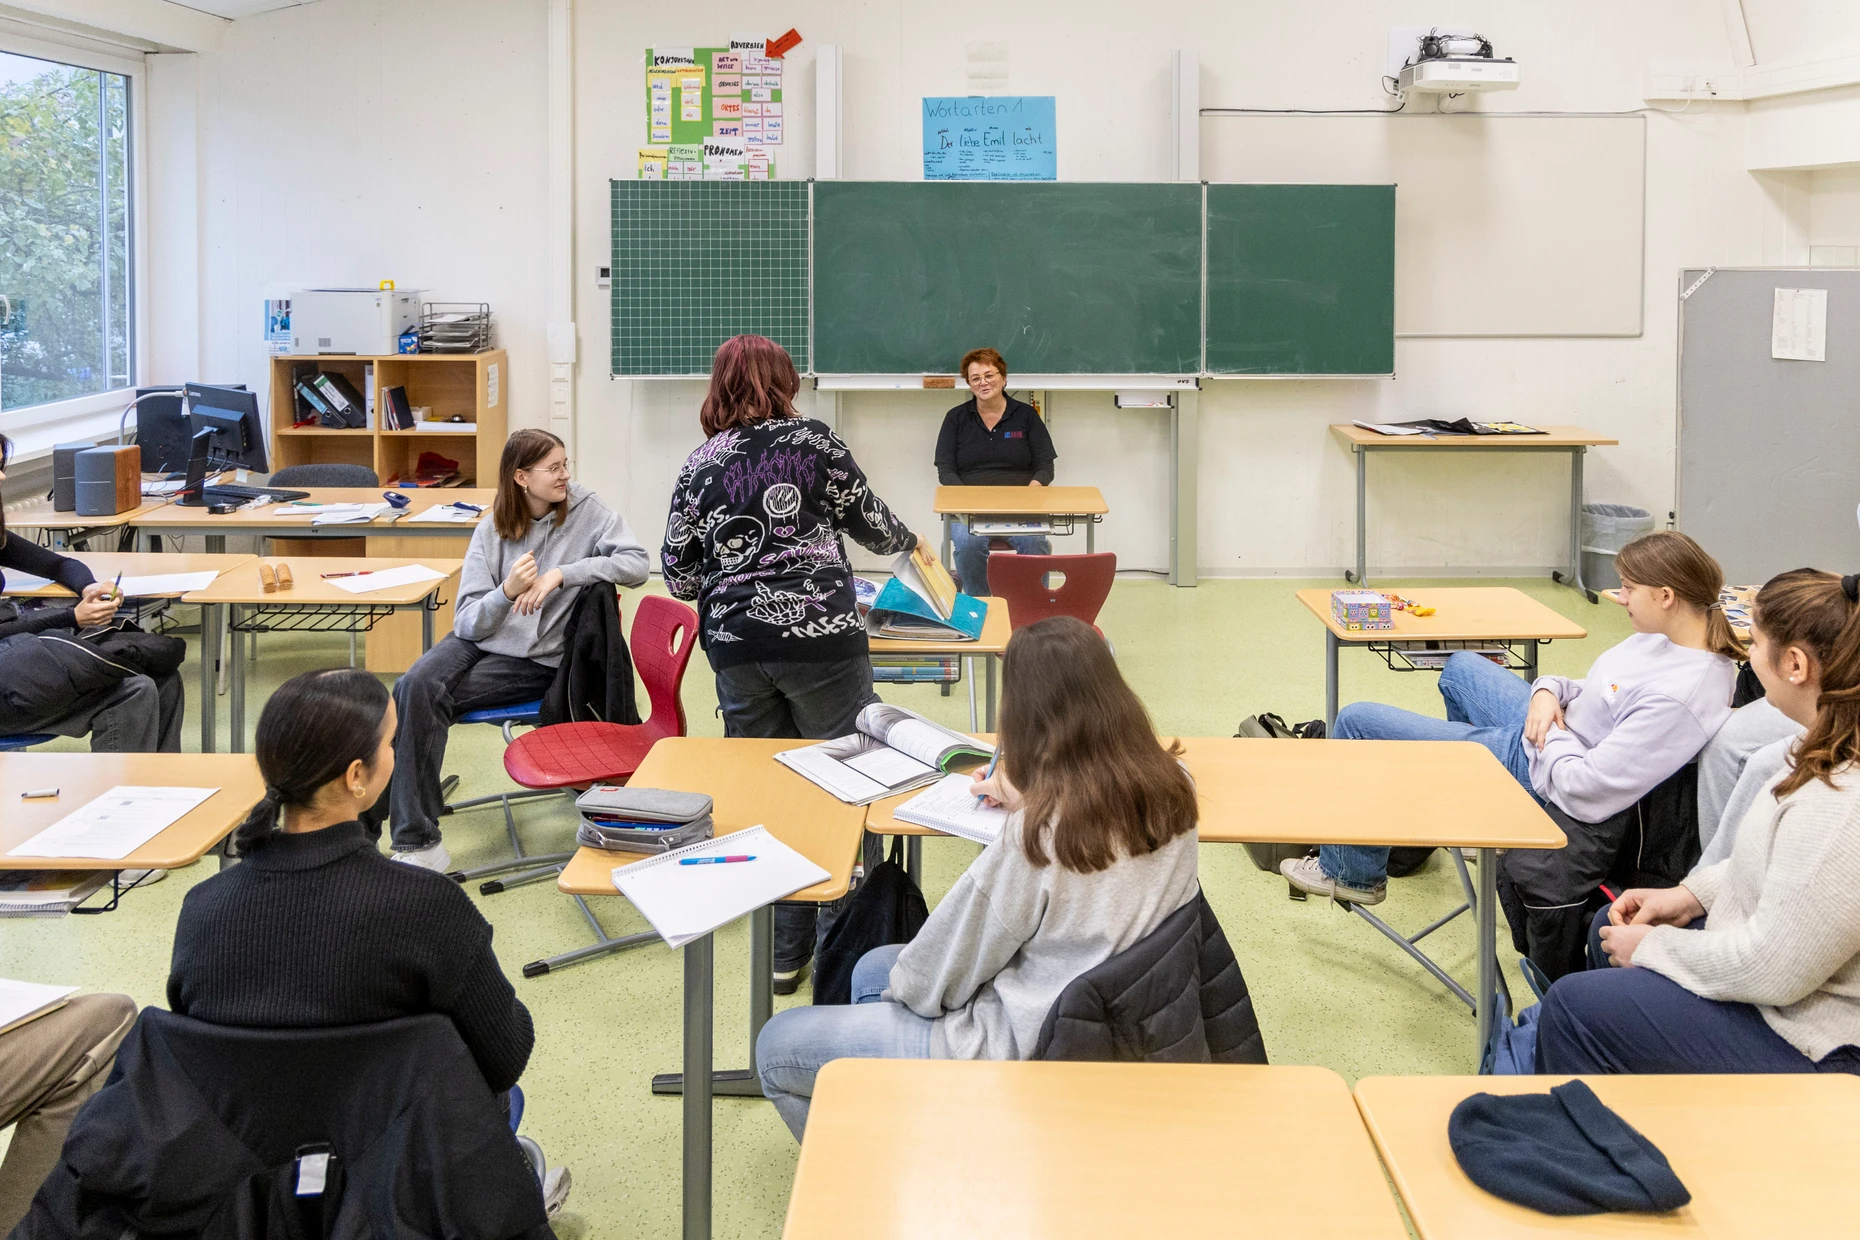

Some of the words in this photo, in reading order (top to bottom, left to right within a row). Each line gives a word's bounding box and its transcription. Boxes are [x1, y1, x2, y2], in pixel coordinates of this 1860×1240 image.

[730, 41, 764, 49] ADVERBIEN
[720, 104, 740, 112] ORTES
[924, 98, 1007, 118] Wortarten
[1012, 99, 1022, 112] 1
[719, 127, 739, 136] ZEIT
[940, 135, 953, 149] Der
[960, 134, 980, 148] liebe
[983, 131, 1006, 146] Emil
[1012, 132, 1042, 146] lacht
[704, 144, 743, 156] PRONOMEN
